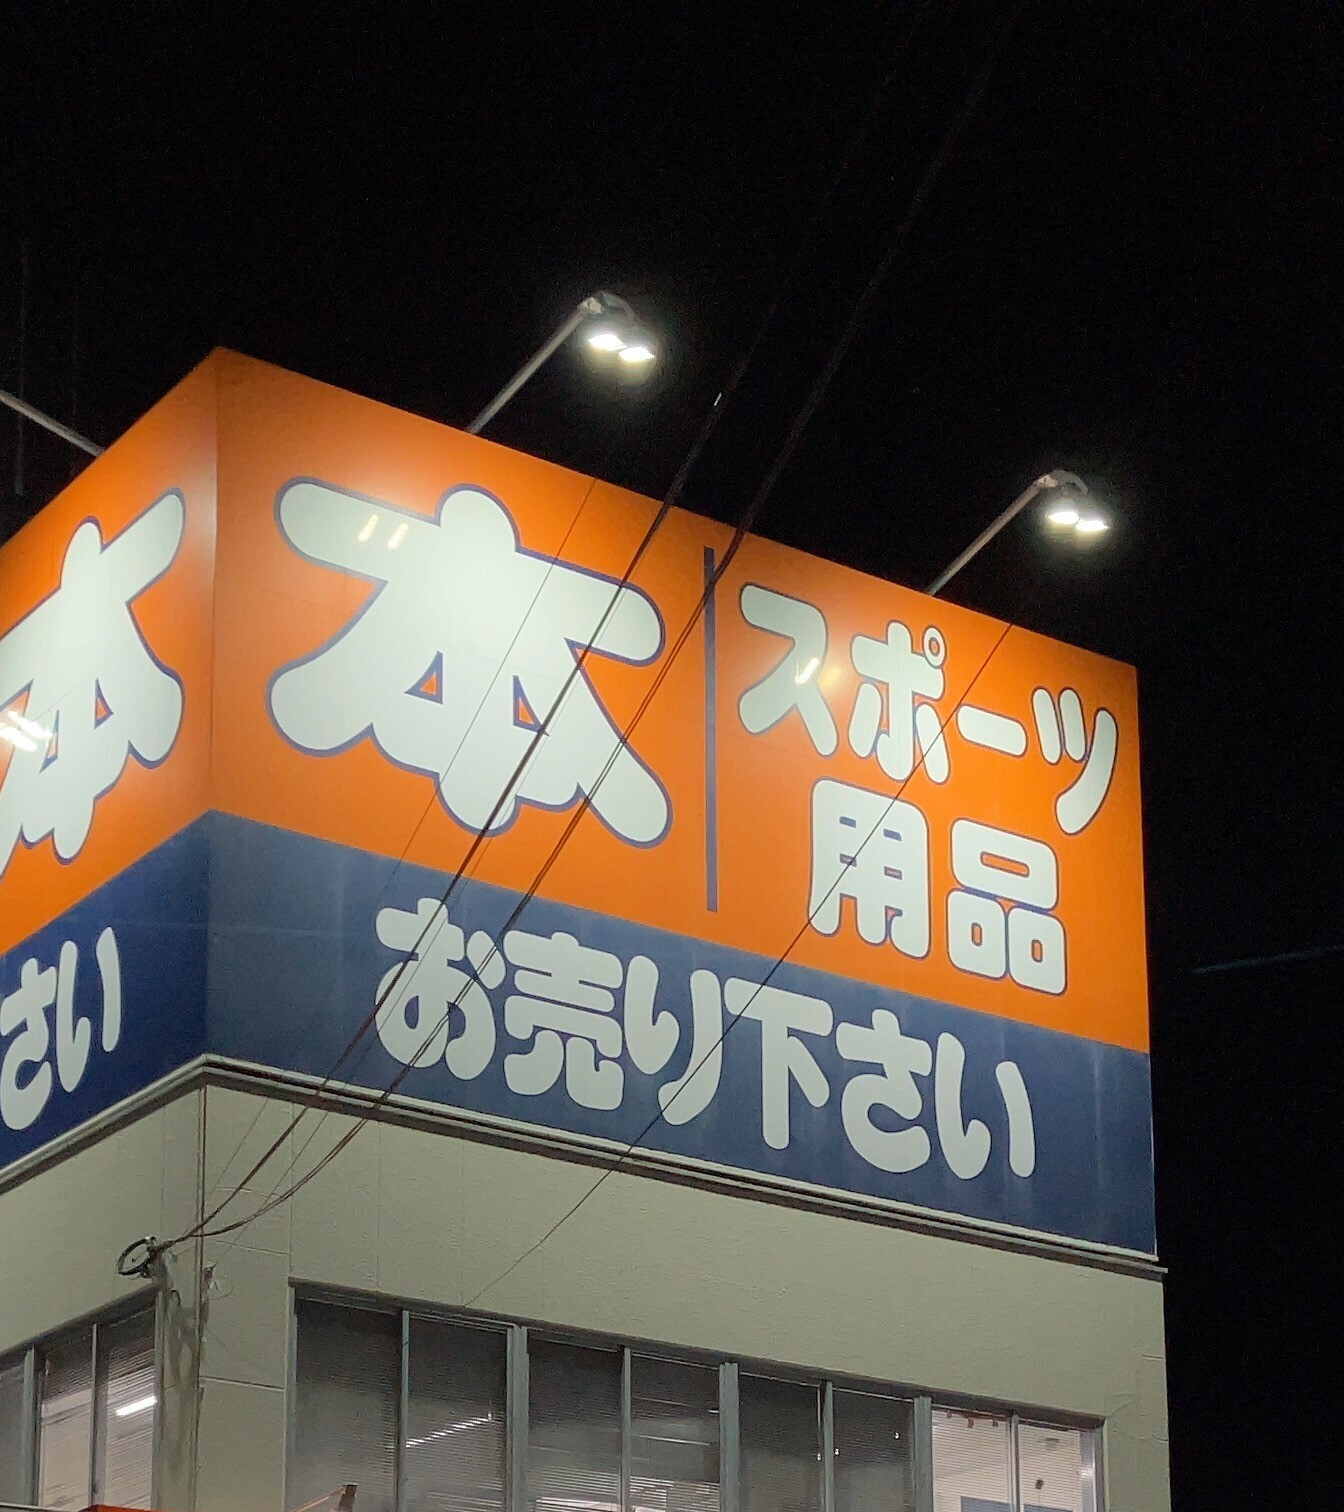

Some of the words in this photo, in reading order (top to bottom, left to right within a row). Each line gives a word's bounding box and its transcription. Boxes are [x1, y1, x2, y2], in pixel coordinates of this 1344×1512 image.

[267, 475, 672, 848] 本
[738, 582, 1119, 836] スポーツ
[807, 778, 1068, 996] 用品
[374, 897, 1035, 1180] お売り下さい
